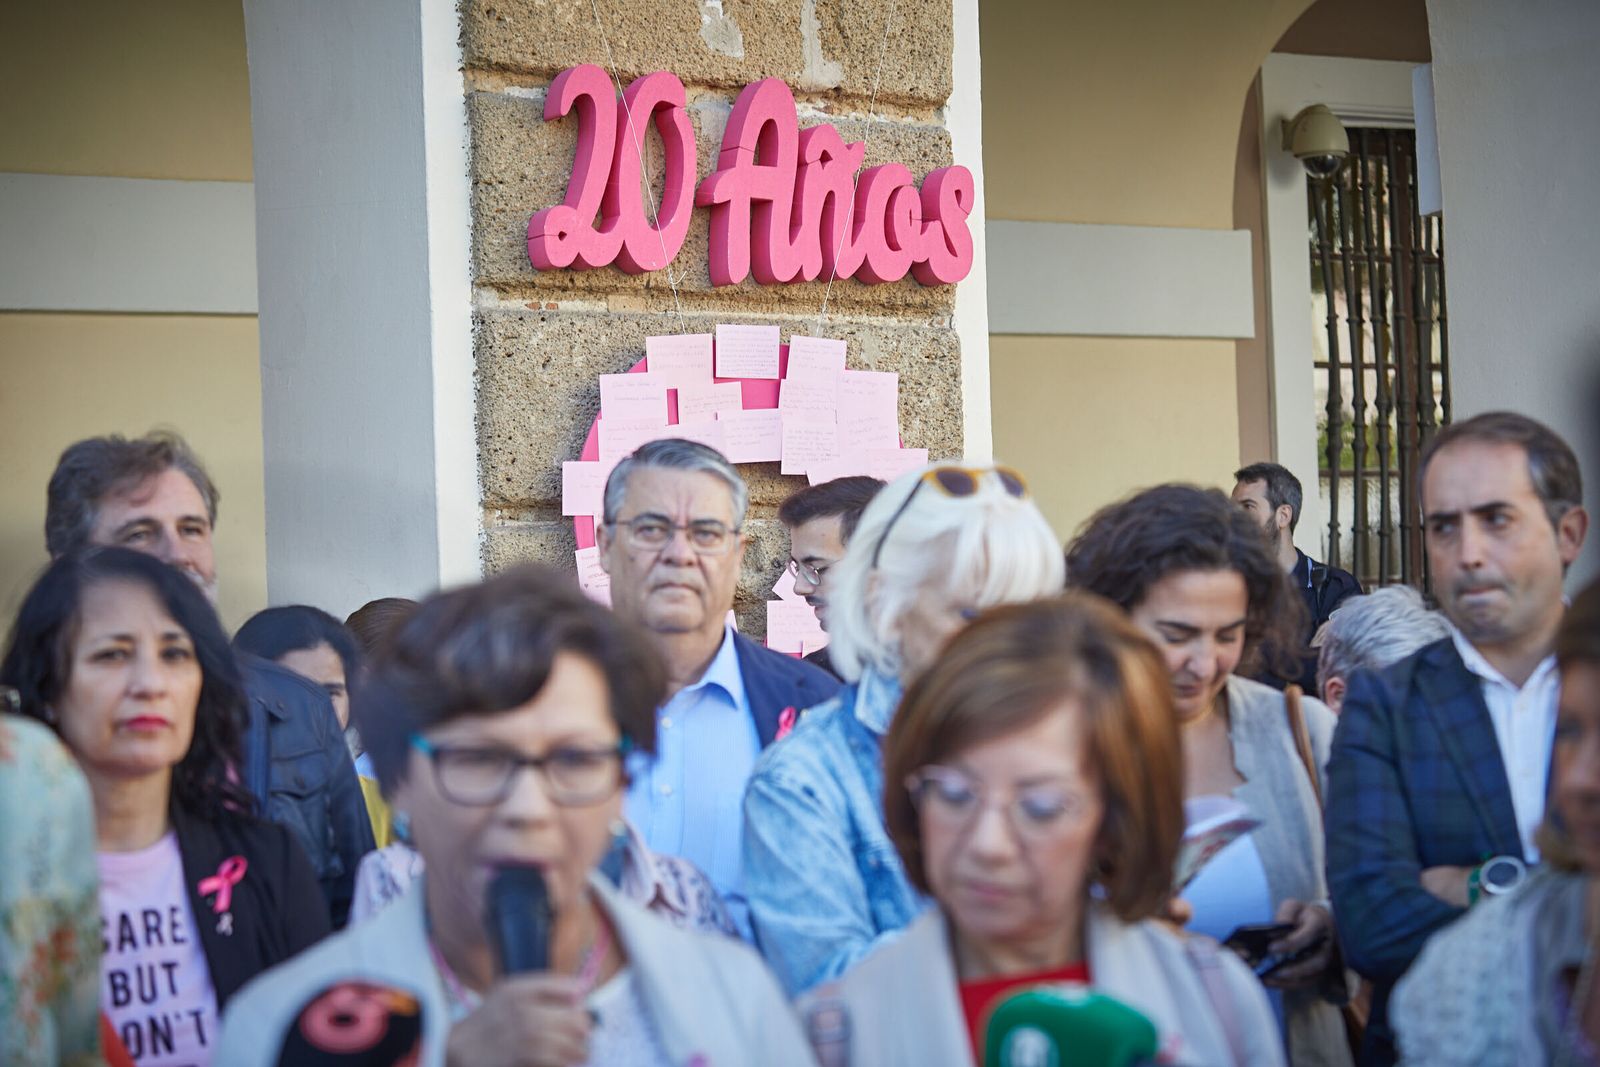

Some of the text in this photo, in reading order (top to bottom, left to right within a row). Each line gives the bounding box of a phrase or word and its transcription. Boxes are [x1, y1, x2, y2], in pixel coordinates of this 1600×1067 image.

[527, 64, 975, 287] 20 Años
[108, 962, 179, 1008] BUT
